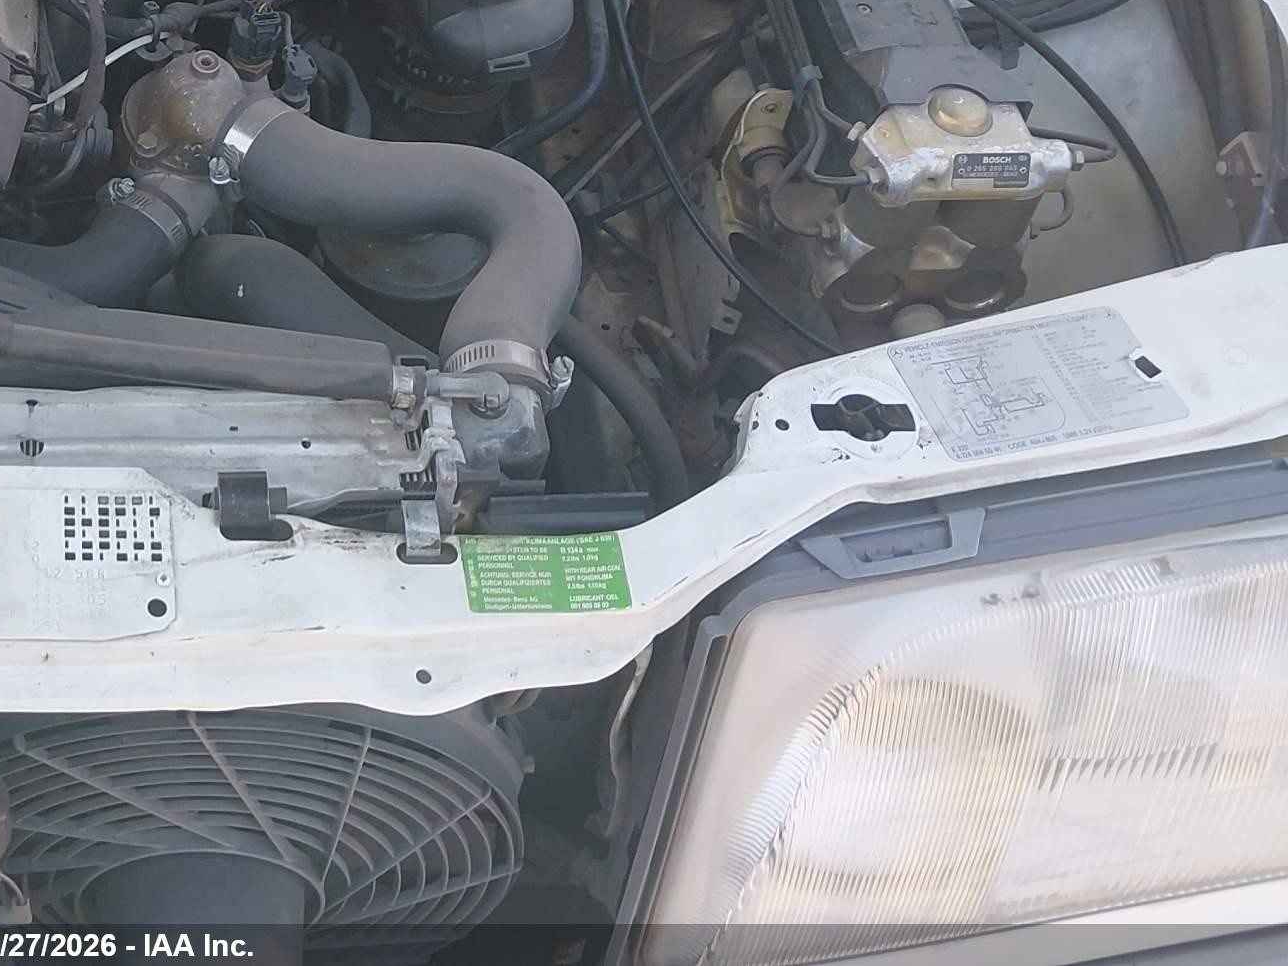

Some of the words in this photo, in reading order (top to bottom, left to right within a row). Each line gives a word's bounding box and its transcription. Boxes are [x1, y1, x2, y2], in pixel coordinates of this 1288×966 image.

[983, 156, 1012, 164] BOSCH
[477, 554, 507, 562] SERVICED
[516, 554, 549, 562] QUALIFIED
